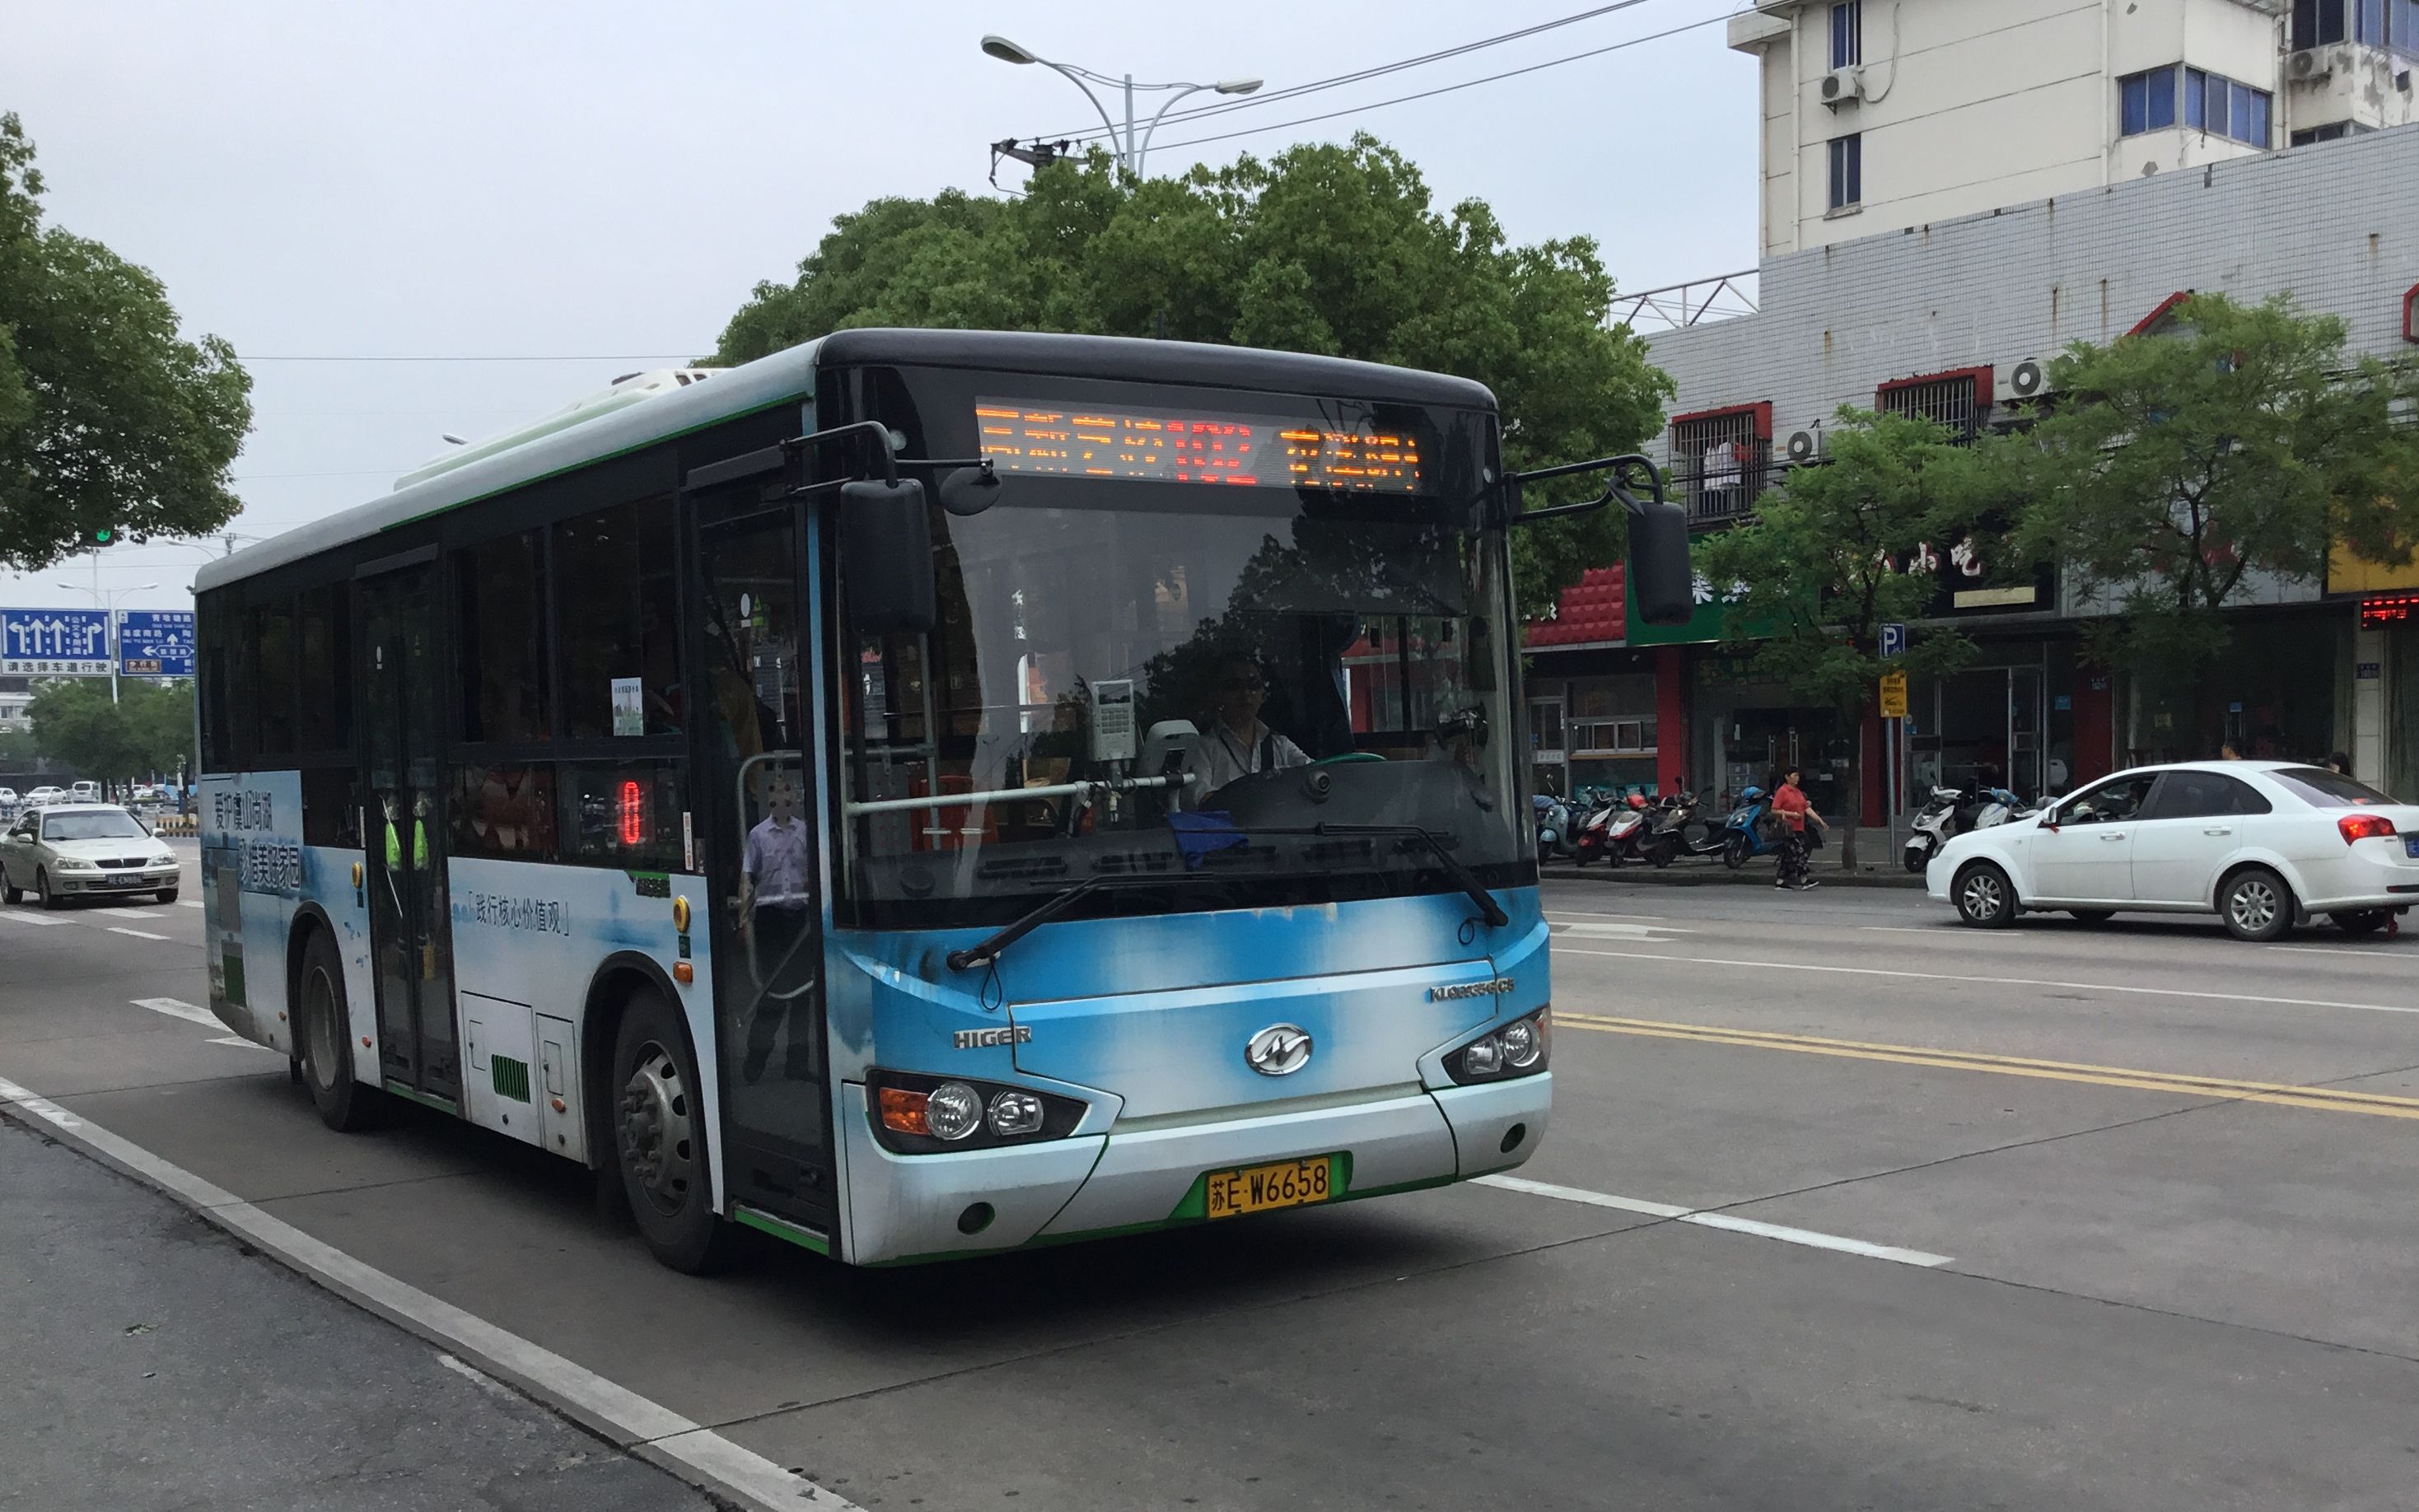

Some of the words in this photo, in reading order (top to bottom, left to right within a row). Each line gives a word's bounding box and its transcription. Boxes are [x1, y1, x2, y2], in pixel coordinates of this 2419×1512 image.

[1166, 421, 1257, 484] 102
[7, 661, 108, 673] 请选择车道行驶
[214, 790, 273, 832] 爱护虞山尚湖
[240, 838, 301, 889] 珍惜美好家园
[953, 1026, 1032, 1049] HIGER
